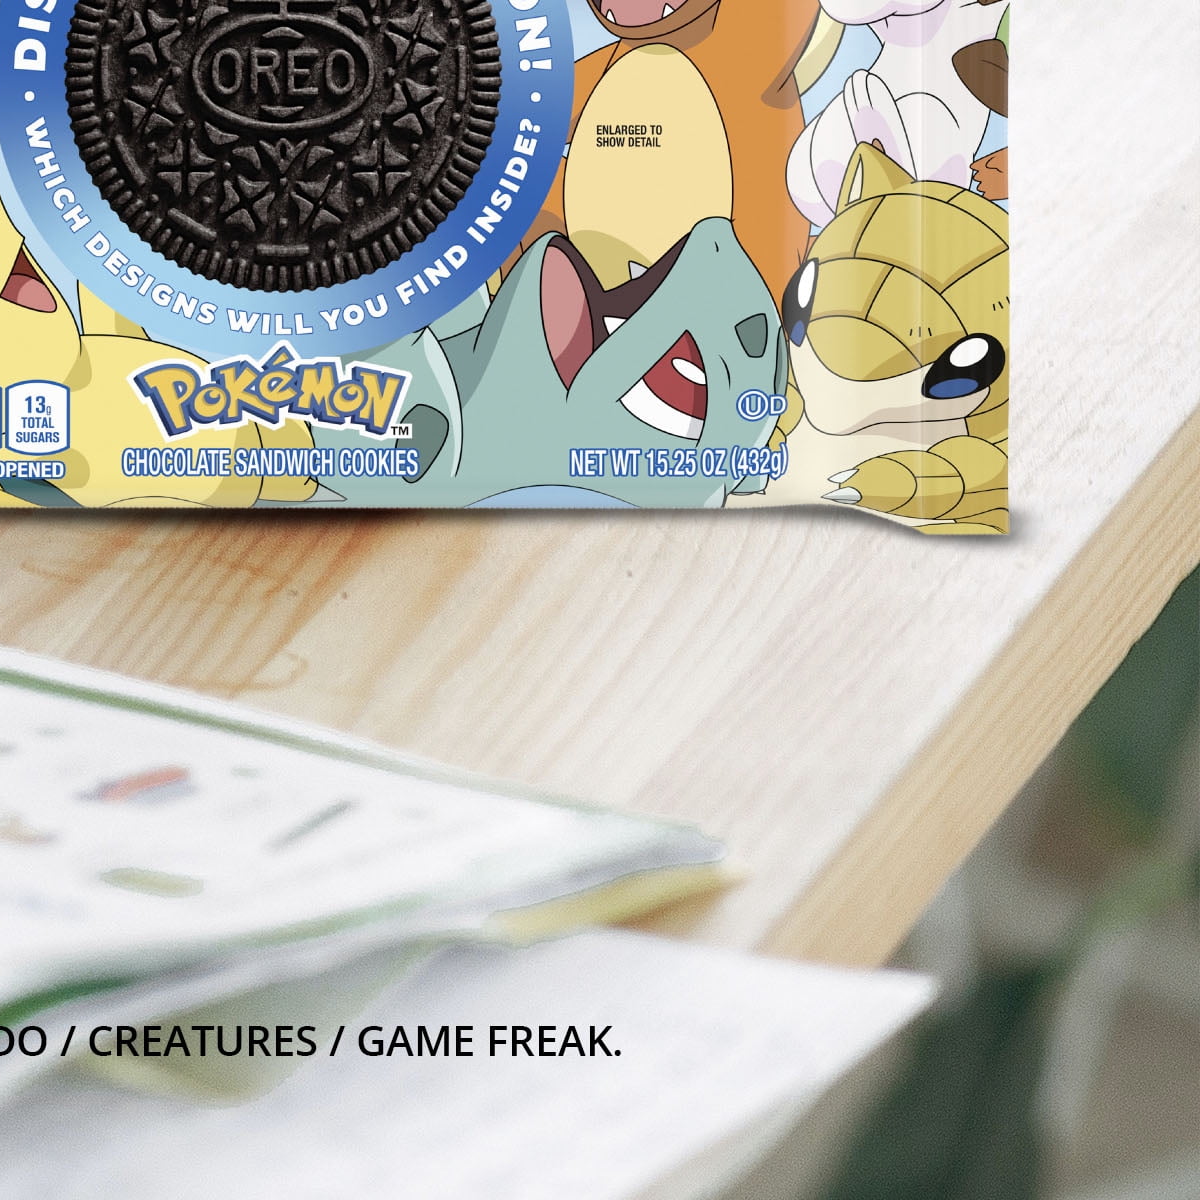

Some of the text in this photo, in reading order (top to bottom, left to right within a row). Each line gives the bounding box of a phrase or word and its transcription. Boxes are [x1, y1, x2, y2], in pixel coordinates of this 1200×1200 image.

[210, 46, 357, 97] OREO
[596, 124, 663, 136] ENLARGED TO
[596, 136, 661, 148] SHOW DETAIL
[24, 115, 542, 335] WHICH DESIGNS WILL YOU FIND INSIDE?
[20, 416, 55, 429] TOTAL
[15, 431, 60, 444] SUGARS
[122, 448, 419, 476] CHOCOLATE SANDWICH COOKIES
[570, 443, 788, 480] NET WT 15.25 OZ (432g)
